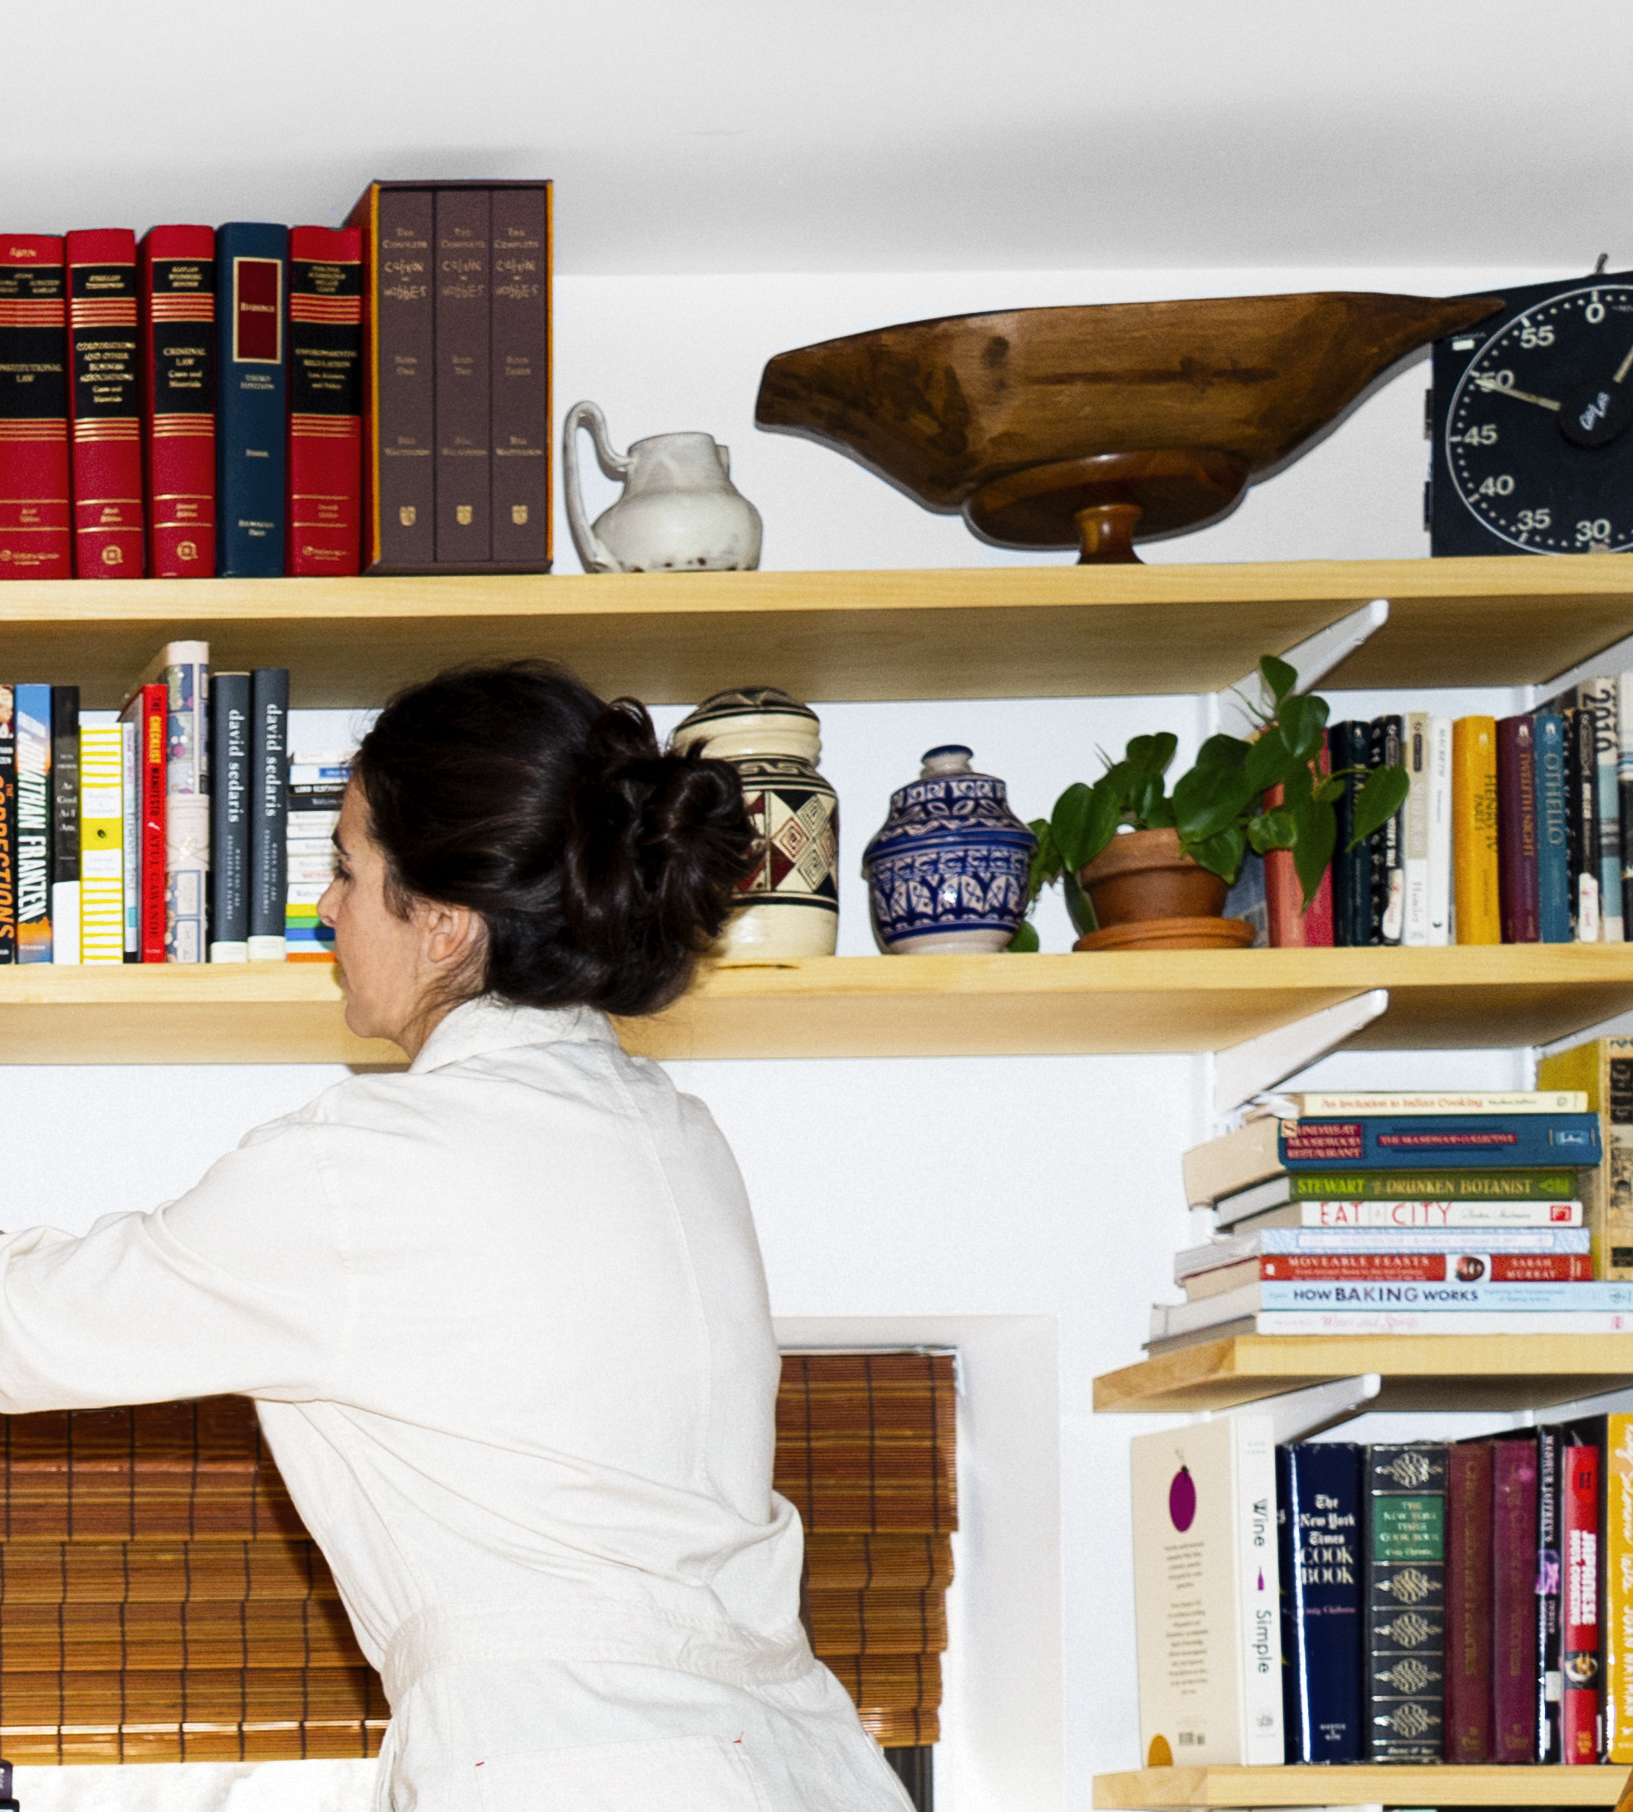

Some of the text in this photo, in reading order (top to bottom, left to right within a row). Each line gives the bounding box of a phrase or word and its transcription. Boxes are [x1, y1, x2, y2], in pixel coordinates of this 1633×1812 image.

[1586, 303, 1605, 324] 0
[1521, 326, 1555, 348] 55
[1465, 425, 1498, 445] 45
[1481, 476, 1514, 495] 40
[1517, 509, 1550, 531] 35
[1576, 520, 1611, 541] 30
[1297, 1179, 1365, 1193] STEWART
[1320, 1201, 1452, 1224] EAT CITY
[1294, 1288, 1478, 1301] HOW BAKING WORKS
[1254, 1610, 1271, 1673] Simple
